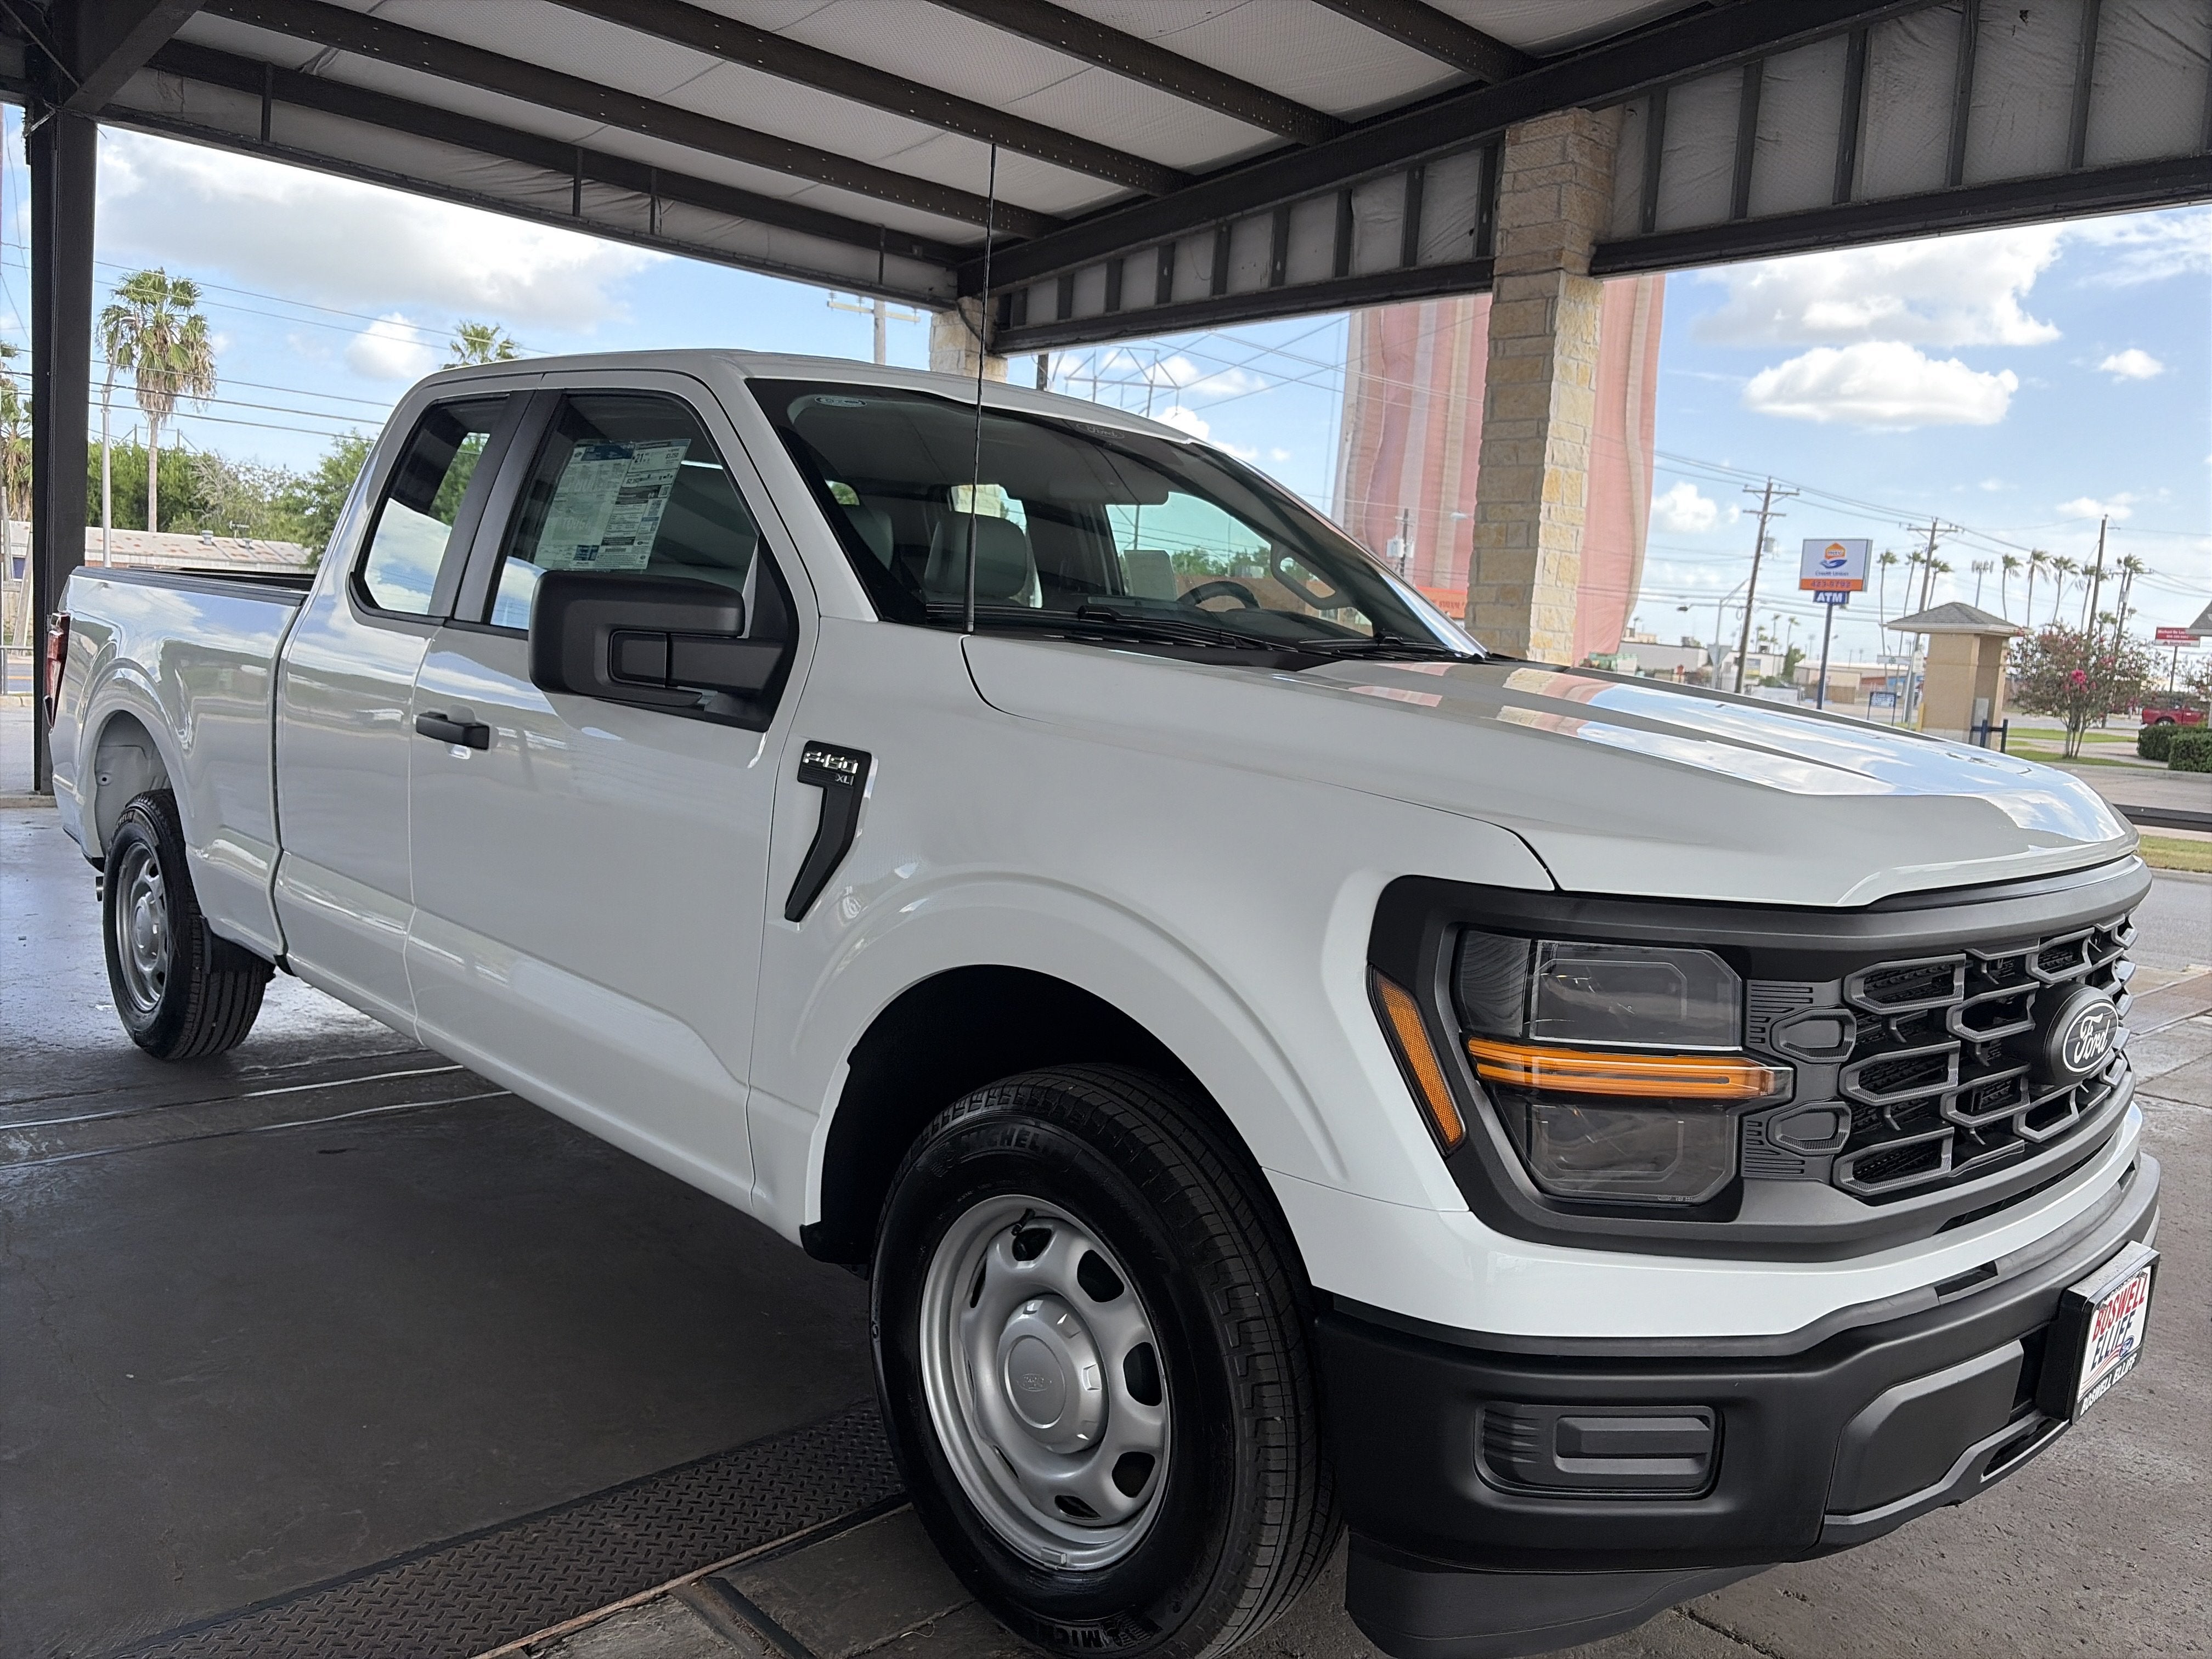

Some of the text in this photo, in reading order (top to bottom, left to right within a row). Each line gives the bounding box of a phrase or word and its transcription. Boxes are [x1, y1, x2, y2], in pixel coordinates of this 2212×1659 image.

[1816, 592, 1842, 602] ATM
[803, 751, 858, 774] F-150
[2074, 1013, 2110, 1063] Ford
[2092, 1273, 2148, 1343] BOSWELL
[2090, 1309, 2136, 1372] ELLIFF
[2080, 1353, 2137, 1417] BOSWELL ELLIFF
